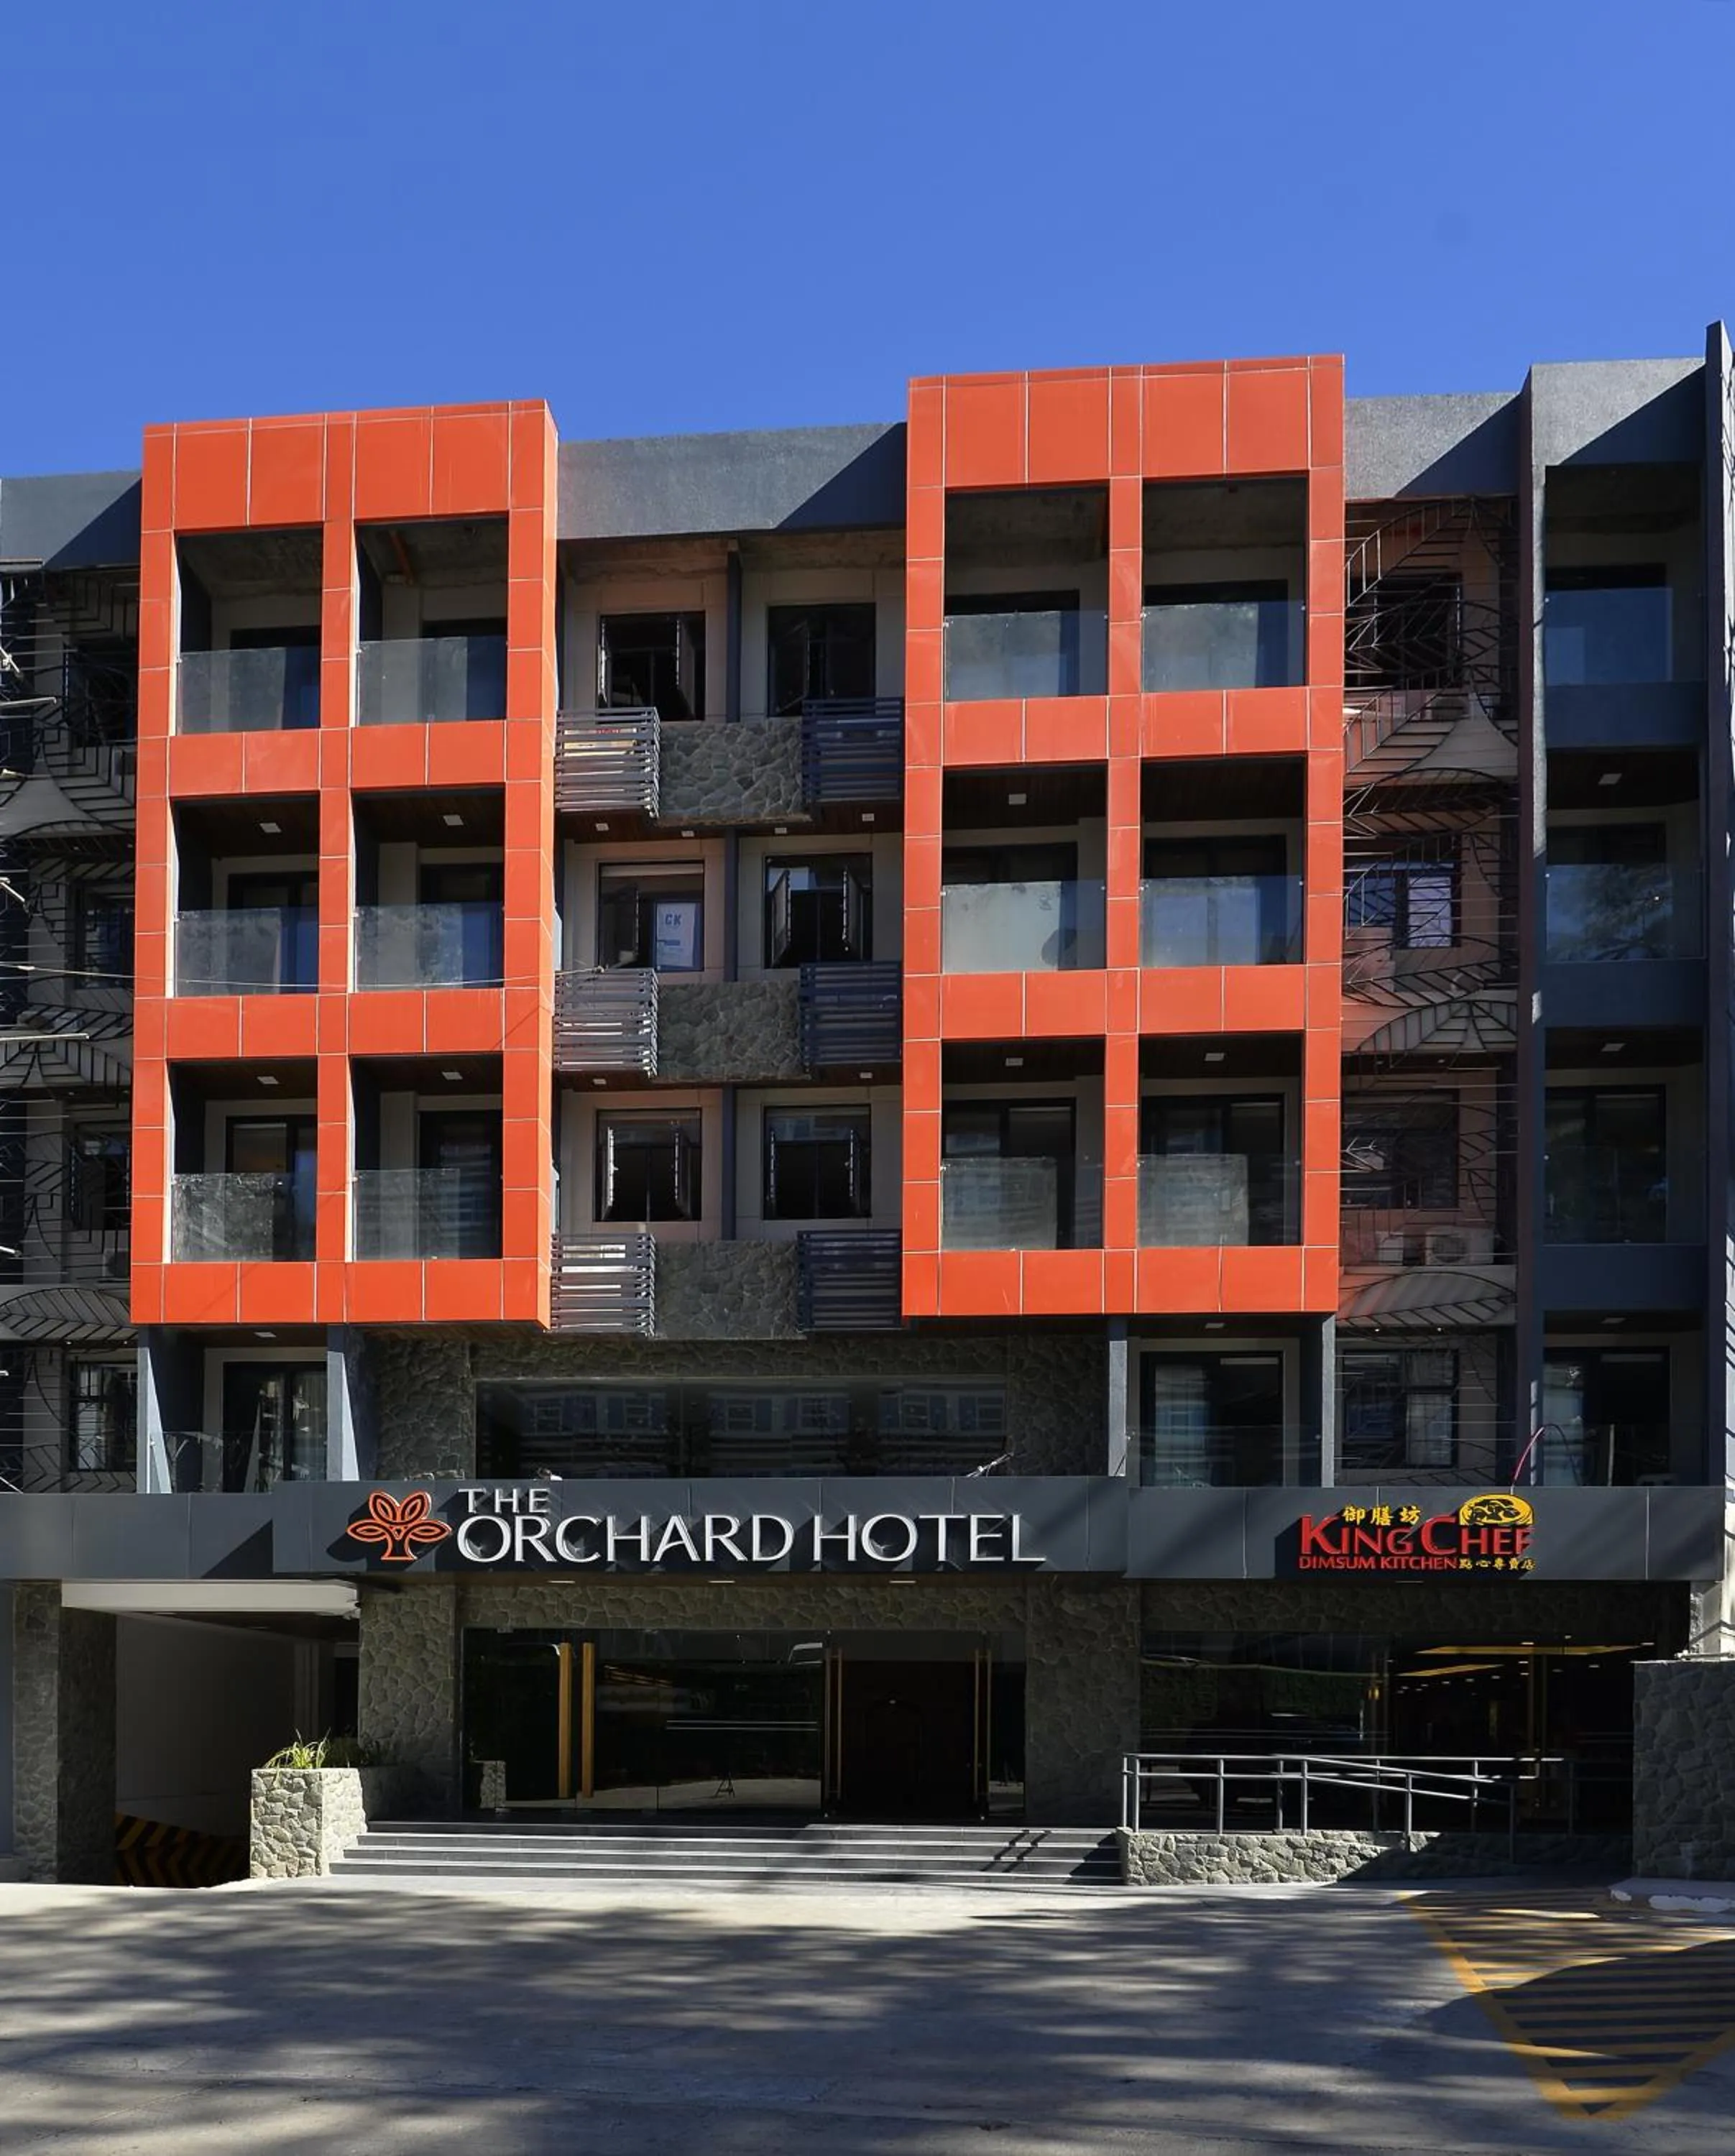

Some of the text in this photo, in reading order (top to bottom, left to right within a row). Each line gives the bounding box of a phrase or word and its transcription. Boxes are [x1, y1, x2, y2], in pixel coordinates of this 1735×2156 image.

[459, 1488, 548, 1514] THE
[1343, 1506, 1421, 1526] 御膳坊
[456, 1514, 1046, 1562] ORCHARD HOTEL
[1298, 1556, 1459, 1570] DIMSUM KITCHEN
